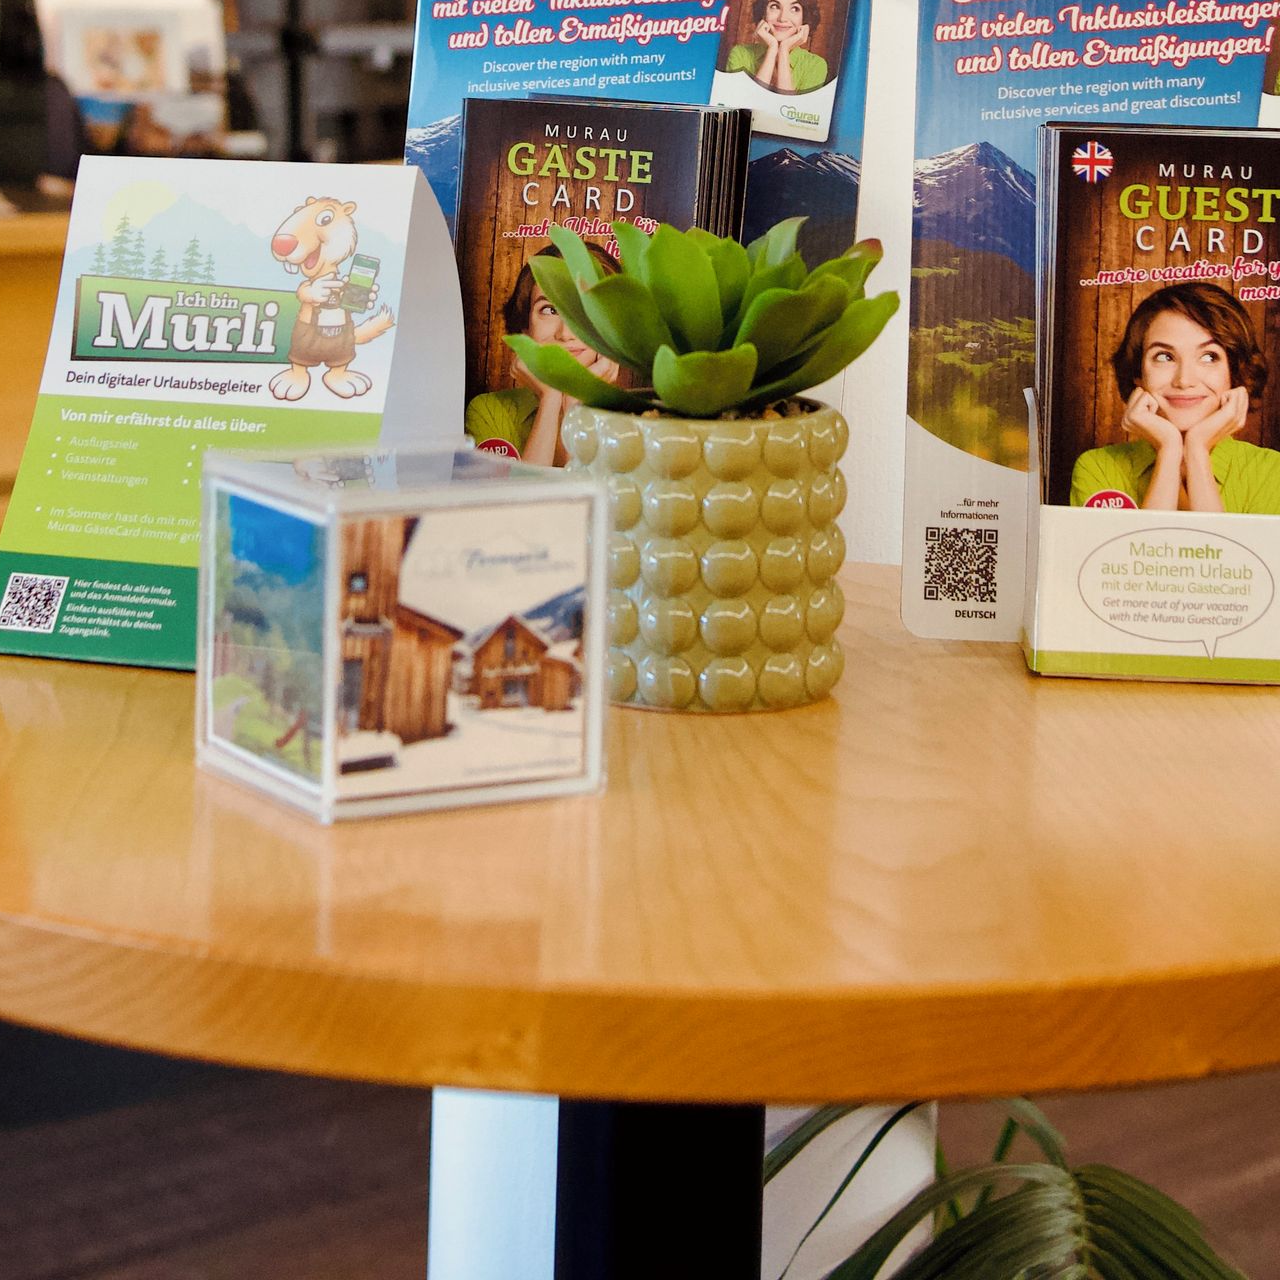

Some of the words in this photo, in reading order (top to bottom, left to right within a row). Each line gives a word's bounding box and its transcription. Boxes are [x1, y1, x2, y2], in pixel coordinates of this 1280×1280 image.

[448, 23, 489, 50] und
[494, 19, 555, 46] tollen
[559, 6, 730, 45] Ermäßigungen!
[935, 16, 977, 43] mit
[980, 13, 1053, 40] vielen
[955, 47, 1002, 75] und
[1008, 42, 1079, 71] tollen
[1082, 27, 1275, 68] Ermäßigungen!
[483, 60, 535, 73] Discover
[537, 59, 557, 71] the
[559, 56, 598, 72] region
[600, 54, 628, 67] with
[630, 53, 665, 69] many
[467, 80, 520, 93] inclusive
[521, 77, 571, 90] services
[573, 75, 595, 87] and
[598, 73, 630, 89] great
[632, 69, 696, 84] discounts!
[997, 86, 1057, 100] Discover
[1060, 83, 1083, 96] the
[1085, 81, 1129, 99] region
[1131, 78, 1164, 93] with
[1166, 75, 1205, 93] many
[981, 105, 1041, 121] inclusive
[1044, 103, 1100, 118] services
[1102, 100, 1128, 114] and
[1131, 99, 1168, 116] great
[1170, 92, 1241, 110] discounts!
[545, 124, 627, 142] MURAU
[507, 142, 654, 184] GÄSTE
[1159, 163, 1253, 180] MURAU
[522, 182, 634, 212] CARD
[503, 217, 557, 238] ...meh
[563, 216, 626, 237] Urla
[1136, 225, 1265, 254] CARD
[1079, 268, 1149, 286] ...more
[1151, 260, 1230, 281] vacation
[1232, 256, 1267, 280] for
[175, 290, 207, 309] Ich
[210, 292, 239, 310] bin
[92, 290, 279, 354] Murli
[66, 371, 96, 385] Dein
[97, 373, 151, 391] digitaler
[153, 377, 263, 396] Urlaubsbegleiter
[61, 408, 88, 422] Von
[89, 411, 113, 424] mir
[115, 412, 171, 428] erfährst
[173, 416, 192, 429] du
[194, 417, 228, 431] alles
[230, 420, 267, 434] über:
[65, 453, 117, 466] Gastwirte
[61, 469, 148, 486] Veranstaltungen
[957, 498, 975, 507] ...für
[977, 499, 999, 507] mehr
[1093, 496, 1124, 508] CARD
[50, 507, 65, 516] Im
[67, 507, 113, 520] Sommer
[115, 512, 138, 523] hast
[139, 514, 154, 524] du
[941, 511, 999, 520] Informationen
[48, 520, 82, 532] Murau
[142, 529, 177, 539] immer
[1129, 542, 1174, 558] Mach
[1178, 544, 1223, 560] mehr
[1101, 563, 1128, 575] aus
[1133, 561, 1195, 577] Deinem
[1200, 564, 1253, 580] Urlaub
[73, 579, 92, 587] Hier
[93, 580, 121, 591] findest
[122, 583, 134, 592] du
[134, 585, 150, 593] alle
[150, 586, 171, 595] Infos
[1102, 581, 1121, 590] mit
[1124, 581, 1144, 591] der
[1146, 582, 1184, 593] Murau
[70, 591, 86, 599] und
[87, 592, 102, 600] das
[102, 593, 177, 607] Anmeldeformular.
[1103, 597, 1121, 608] Get
[1122, 599, 1149, 609] more
[1150, 600, 1168, 609] out
[1170, 600, 1180, 610] of
[1179, 602, 1204, 612] your
[1206, 601, 1248, 612] vacation
[66, 603, 97, 613] Einfach
[137, 610, 154, 619] und
[955, 610, 996, 619] DEUTSCH
[1109, 613, 1132, 621] with
[1133, 613, 1151, 622] the
[1151, 613, 1185, 624] Murau
[1187, 615, 1243, 625] GuestCard!
[60, 625, 111, 638] Zugangslink.
[62, 615, 87, 623] schon
[121, 620, 133, 628] du
[133, 621, 162, 631] deinen
